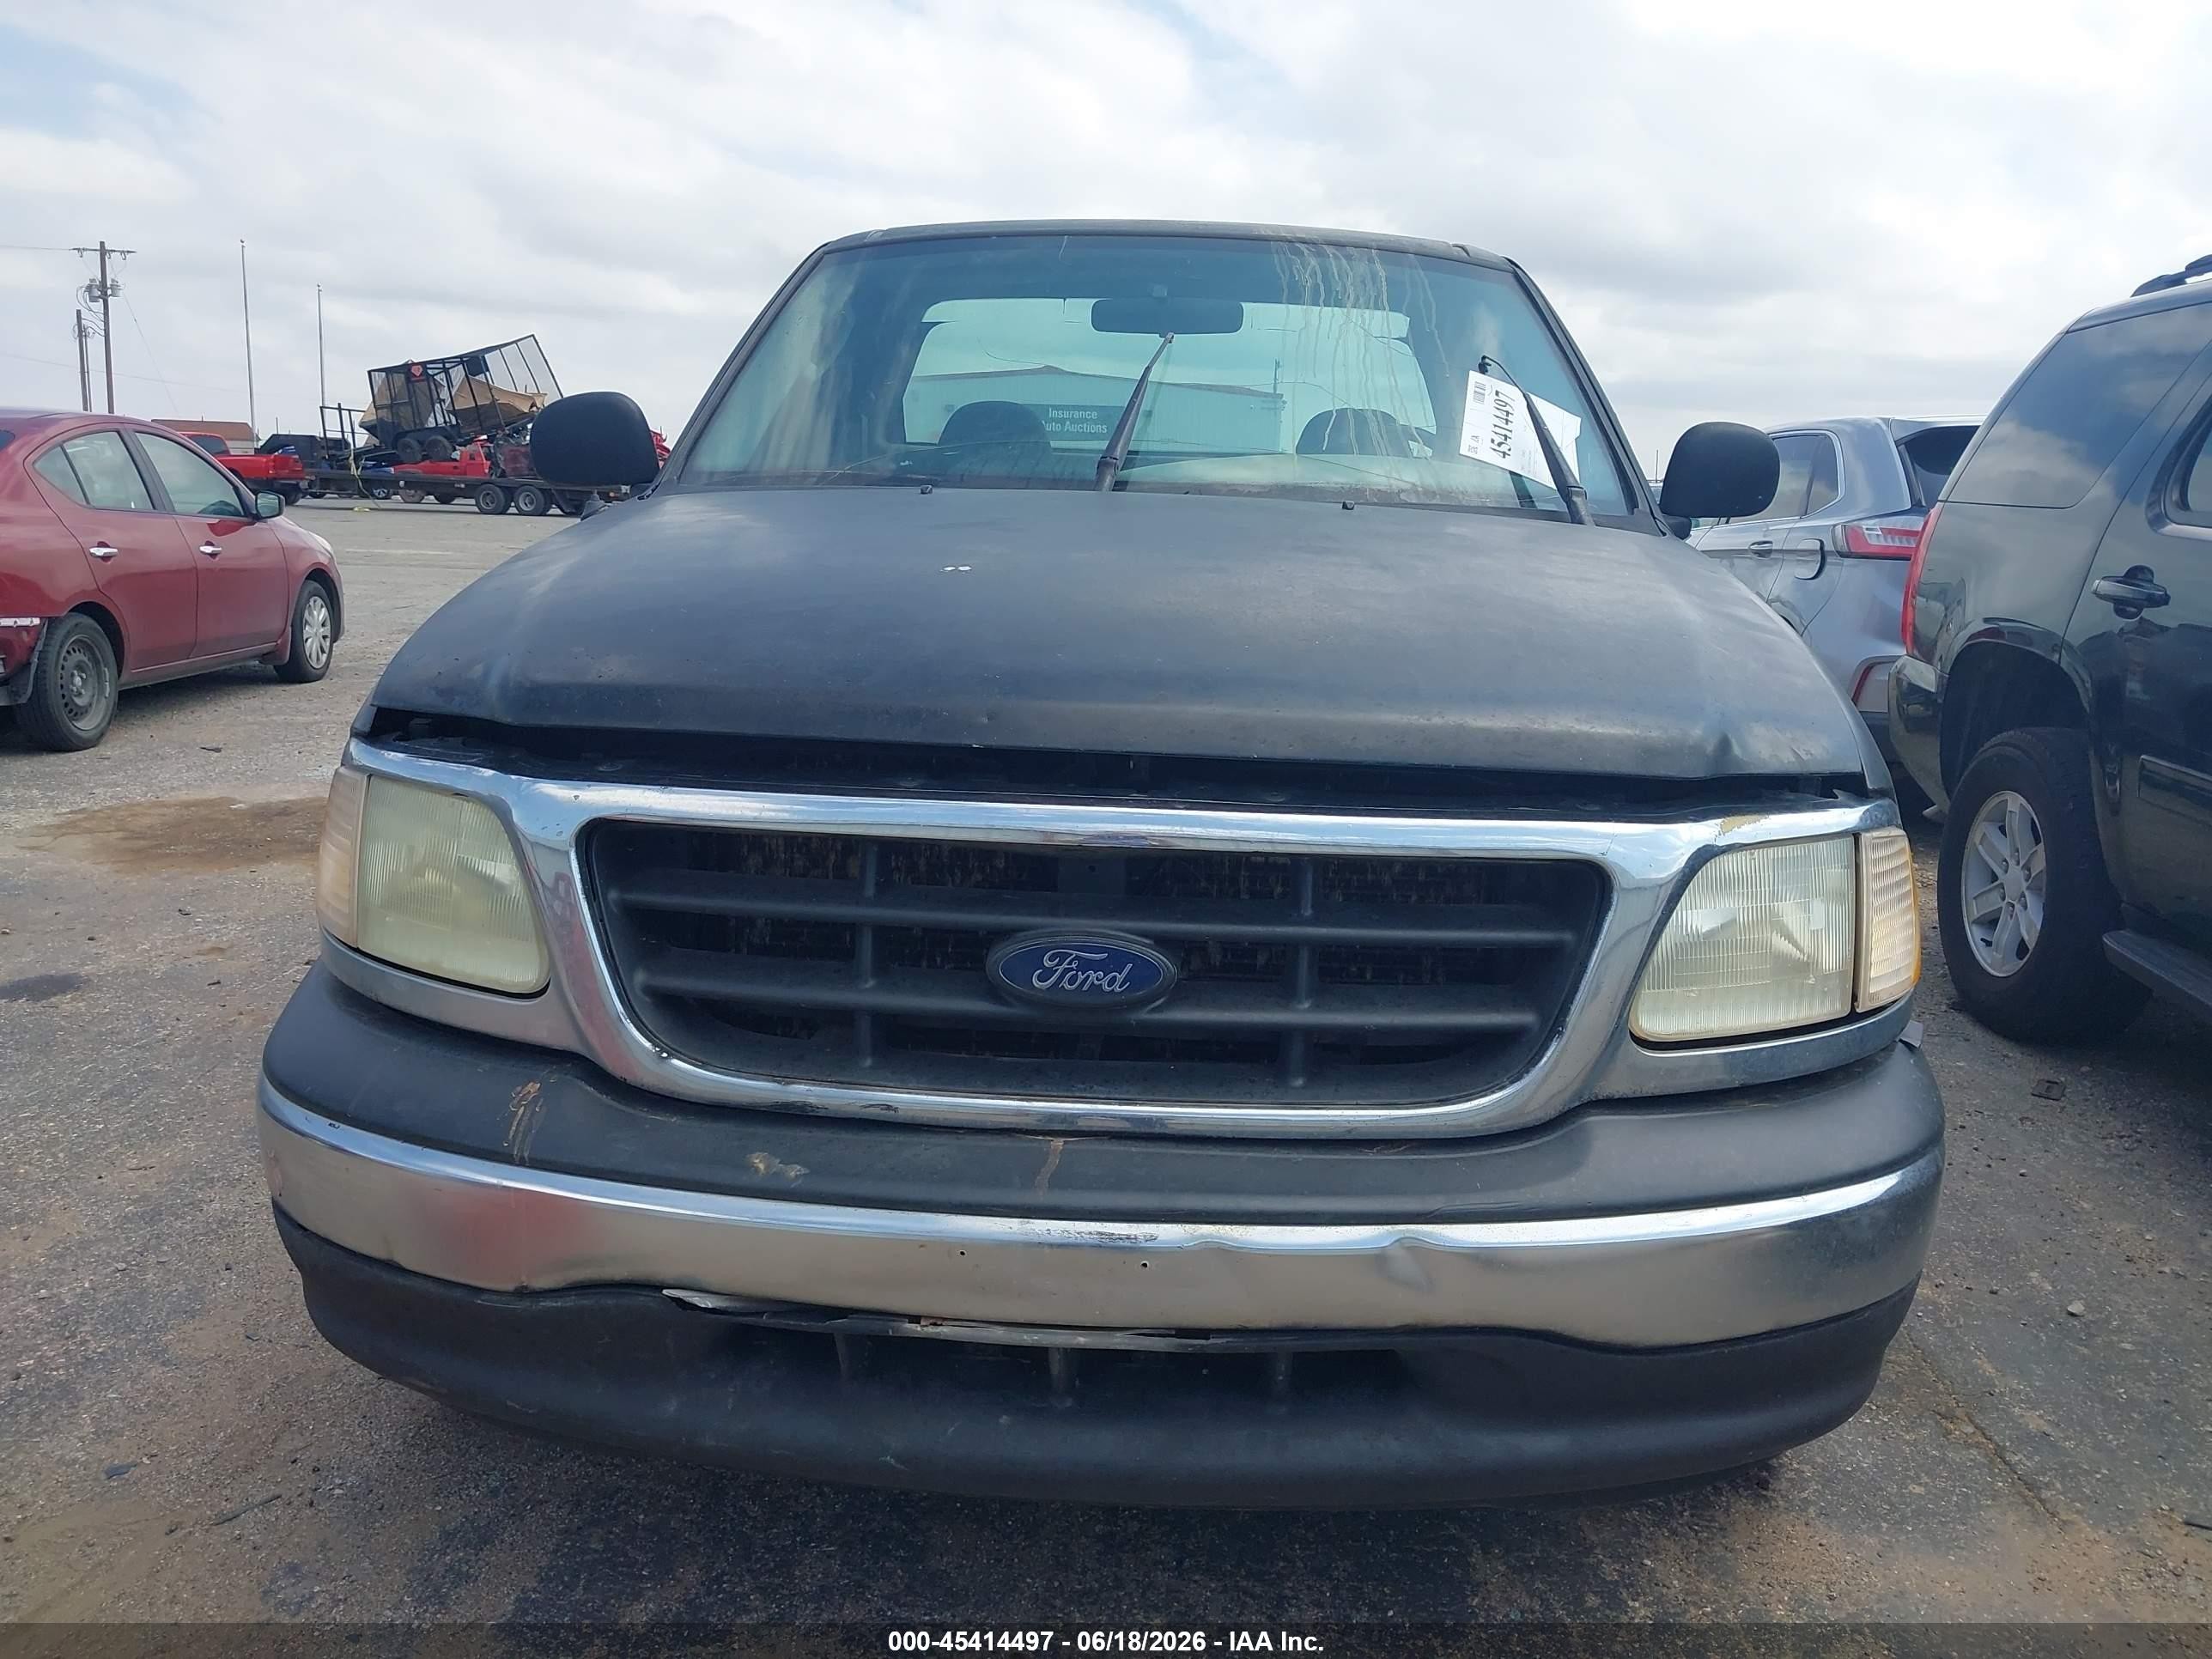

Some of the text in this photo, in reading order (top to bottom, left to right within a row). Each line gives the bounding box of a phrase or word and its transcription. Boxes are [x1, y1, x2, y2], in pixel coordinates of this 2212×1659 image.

[1048, 407, 1098, 420] Insurance
[1065, 421, 1108, 434] Auctions
[1490, 389, 1516, 459] 45414497
[1032, 949, 1133, 993] Ford
